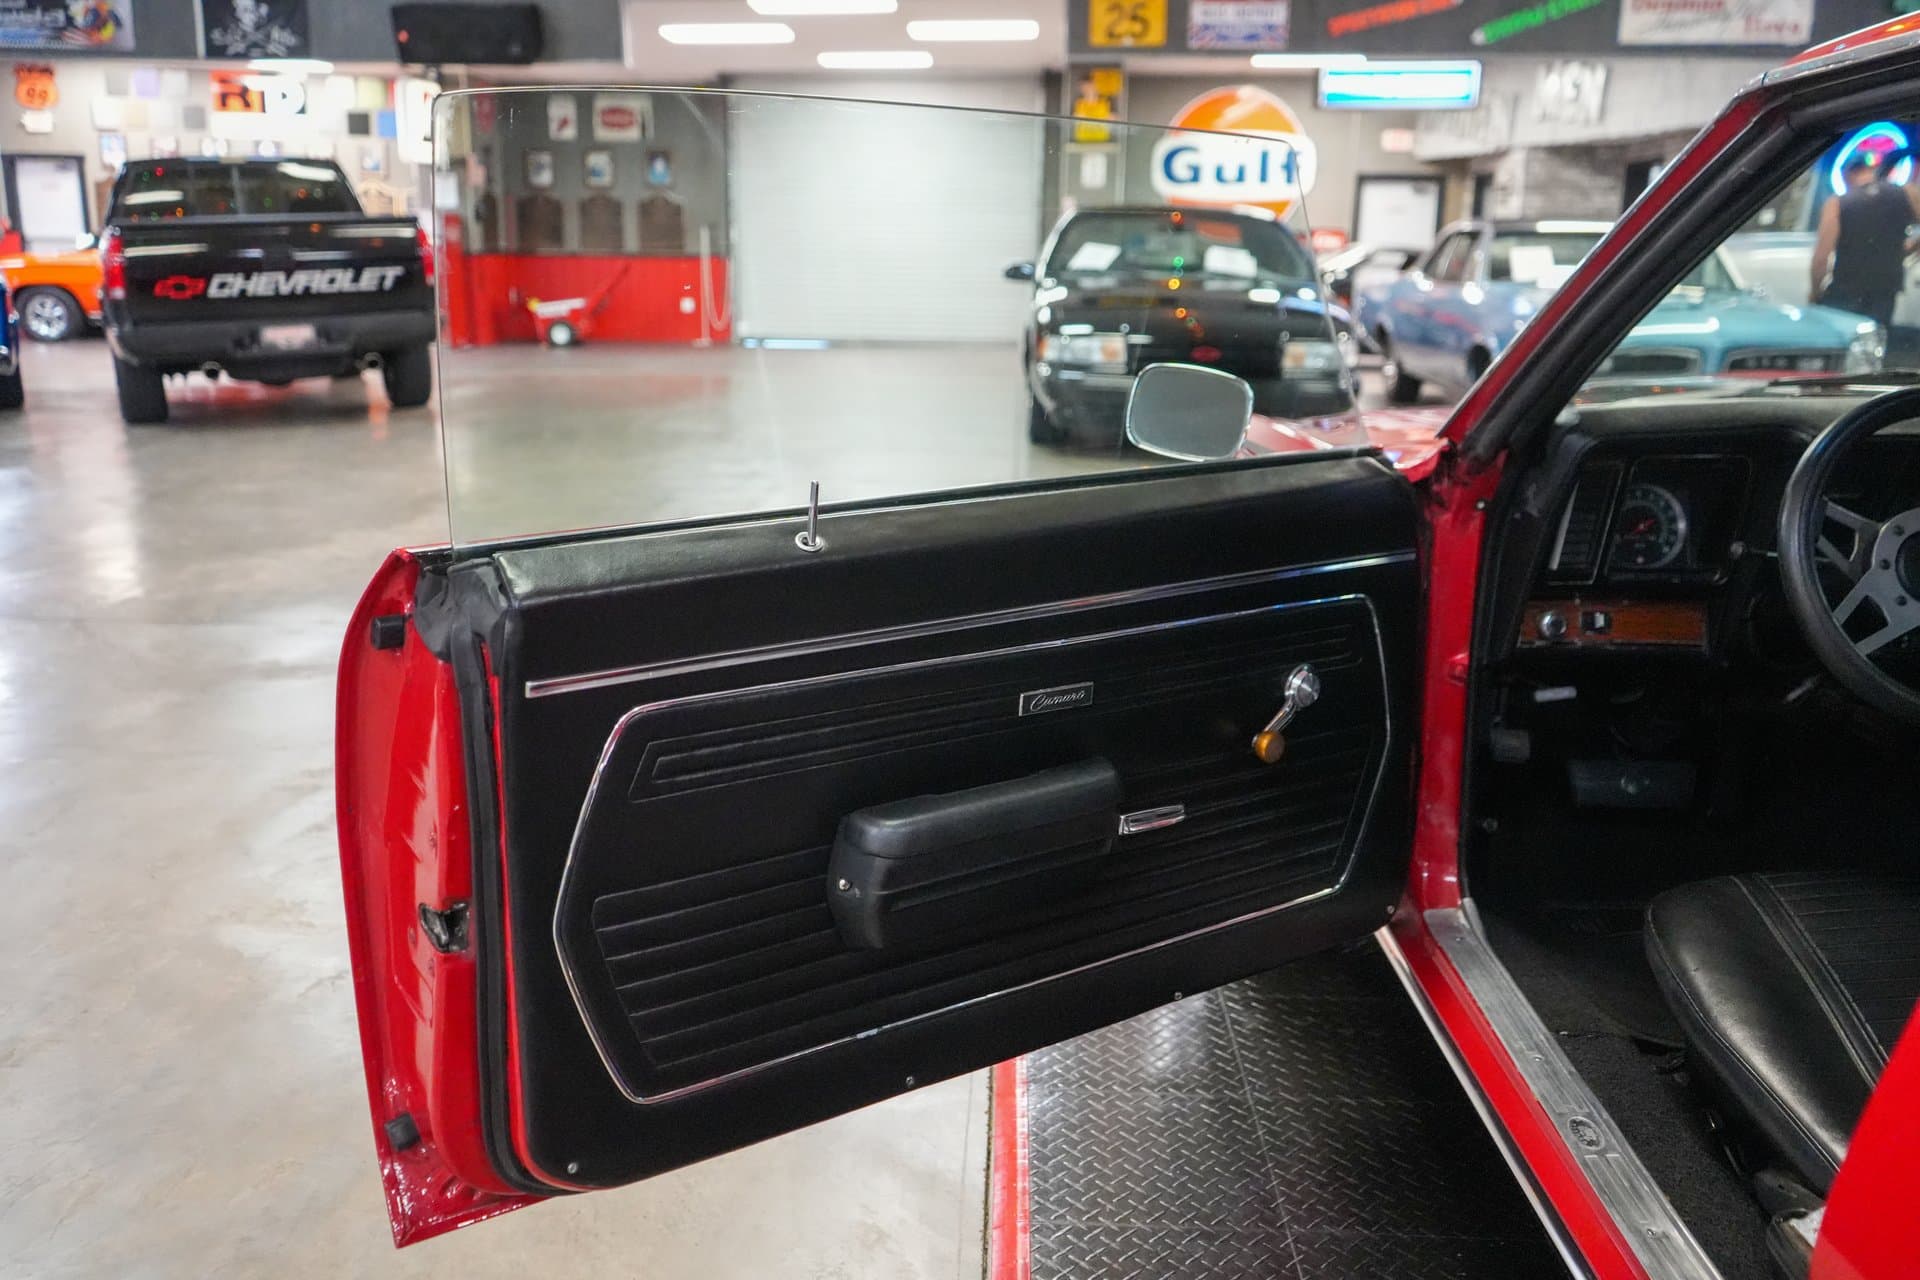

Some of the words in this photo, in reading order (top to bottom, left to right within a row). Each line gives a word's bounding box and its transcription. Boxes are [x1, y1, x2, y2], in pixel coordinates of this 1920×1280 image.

[1162, 146, 1302, 184] Gulf
[206, 265, 405, 299] CHEVROLET
[1030, 690, 1086, 712] Camaro
